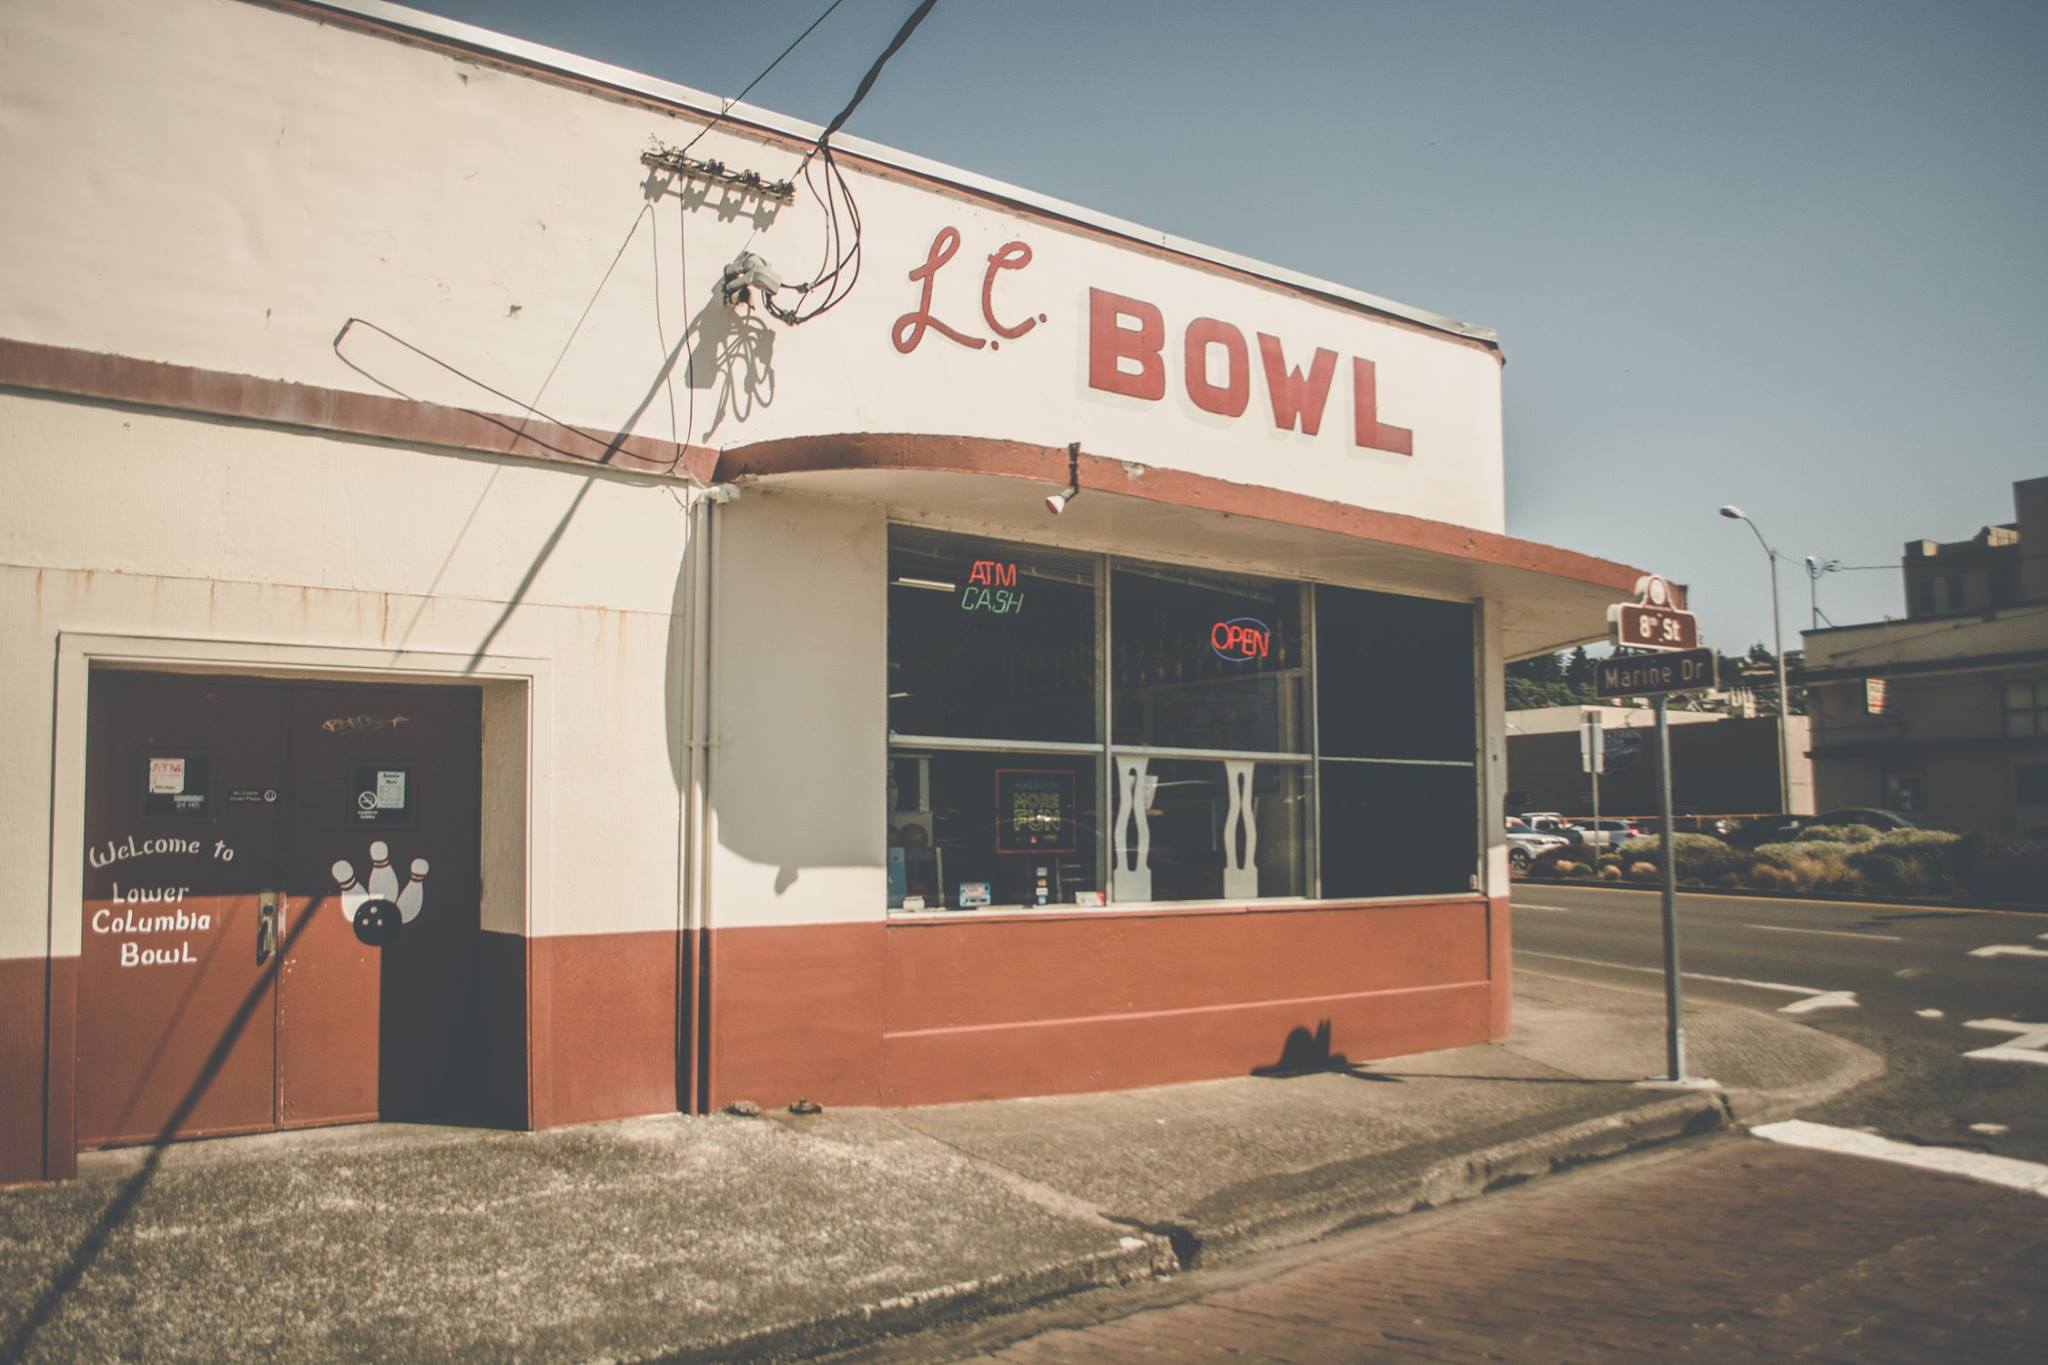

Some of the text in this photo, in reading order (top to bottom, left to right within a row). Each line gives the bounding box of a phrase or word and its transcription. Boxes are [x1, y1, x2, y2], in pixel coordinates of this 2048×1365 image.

[892, 226, 1414, 457] L.C. BOWL
[968, 559, 1018, 587] ATM
[960, 586, 1025, 614] CASH
[1210, 621, 1271, 658] OPEN
[1662, 617, 1683, 642] St
[1604, 658, 1705, 689] Marine Dr
[151, 762, 181, 774] ATM
[1013, 792, 1061, 808] MORE
[1013, 808, 1061, 832] FUN
[213, 839, 235, 862] to
[112, 881, 190, 904] Lower
